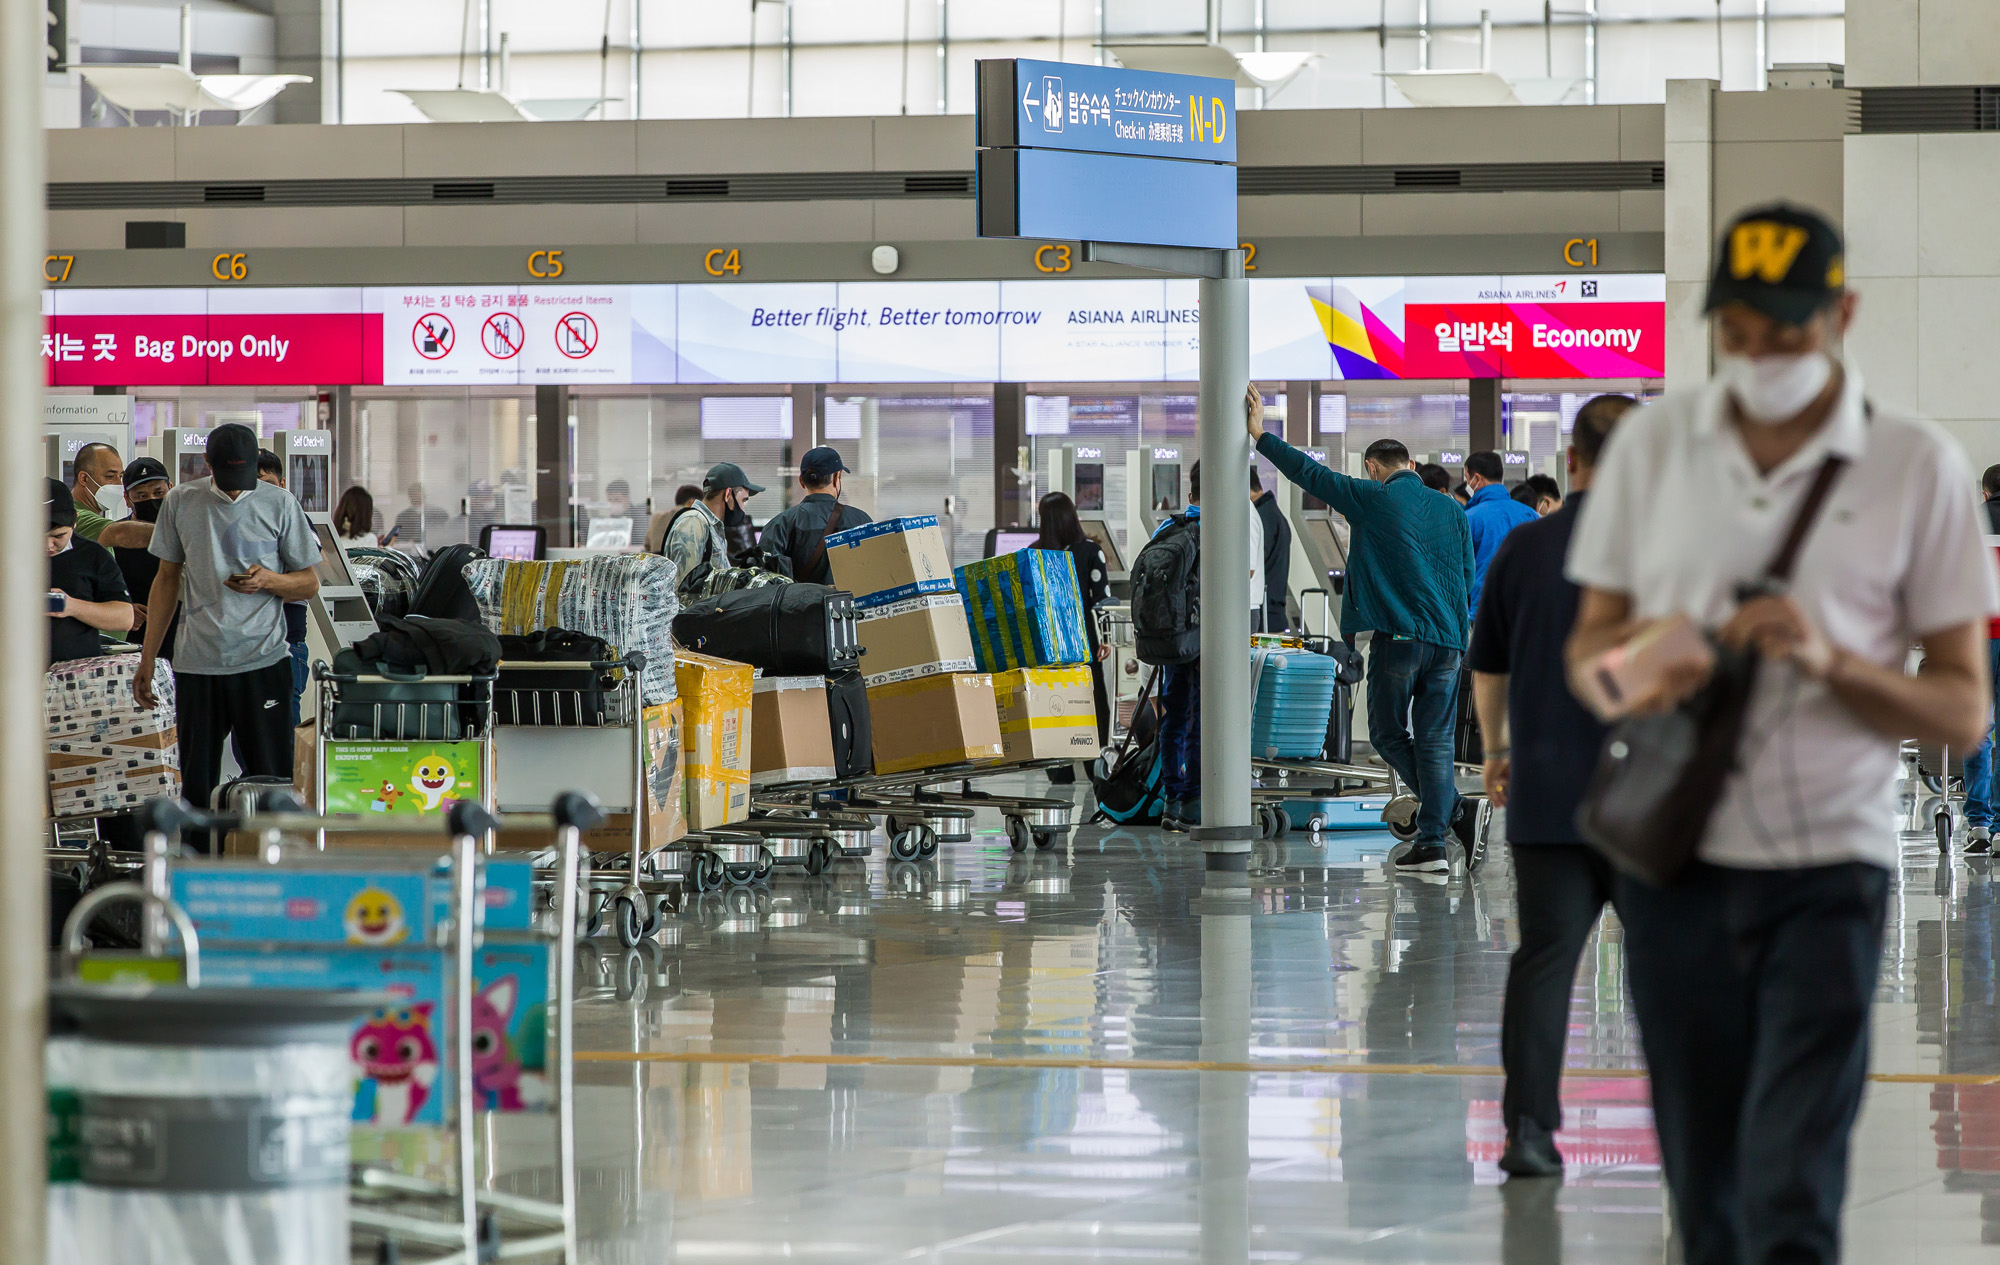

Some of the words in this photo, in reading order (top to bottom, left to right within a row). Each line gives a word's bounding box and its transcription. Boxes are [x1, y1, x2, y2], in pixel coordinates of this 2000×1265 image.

[1068, 91, 1111, 127] 탑승수속
[1114, 87, 1181, 111] チェックインカウンター
[1114, 120, 1146, 141] Check-in
[1189, 94, 1226, 144] N-D
[527, 250, 564, 278] C5
[704, 248, 741, 277] C4
[1034, 244, 1072, 273] C3
[1237, 243, 1256, 270] 2
[1563, 238, 1598, 267] C1
[42, 255, 74, 282] C7
[212, 253, 247, 280] C6
[534, 295, 583, 305] Restricted
[585, 295, 613, 305] Items
[1478, 290, 1512, 300] ASIANA
[1516, 289, 1557, 299] AIRLINES
[751, 308, 813, 327] Better
[815, 307, 871, 331] flight,
[879, 307, 941, 326] Better
[945, 307, 1042, 325] tomorrow
[1067, 310, 1125, 324] ASIANA
[1130, 309, 1200, 324] AIRLINES
[92, 333, 118, 362] 곳
[134, 335, 175, 363] Bag
[181, 335, 234, 363] Drop
[239, 334, 290, 363] Only
[1434, 321, 1513, 352] 일반석
[1532, 323, 1642, 353] Economy
[107, 412, 127, 422] CL7
[293, 435, 303, 448] Self
[1069, 736, 1094, 746] COMMAX
